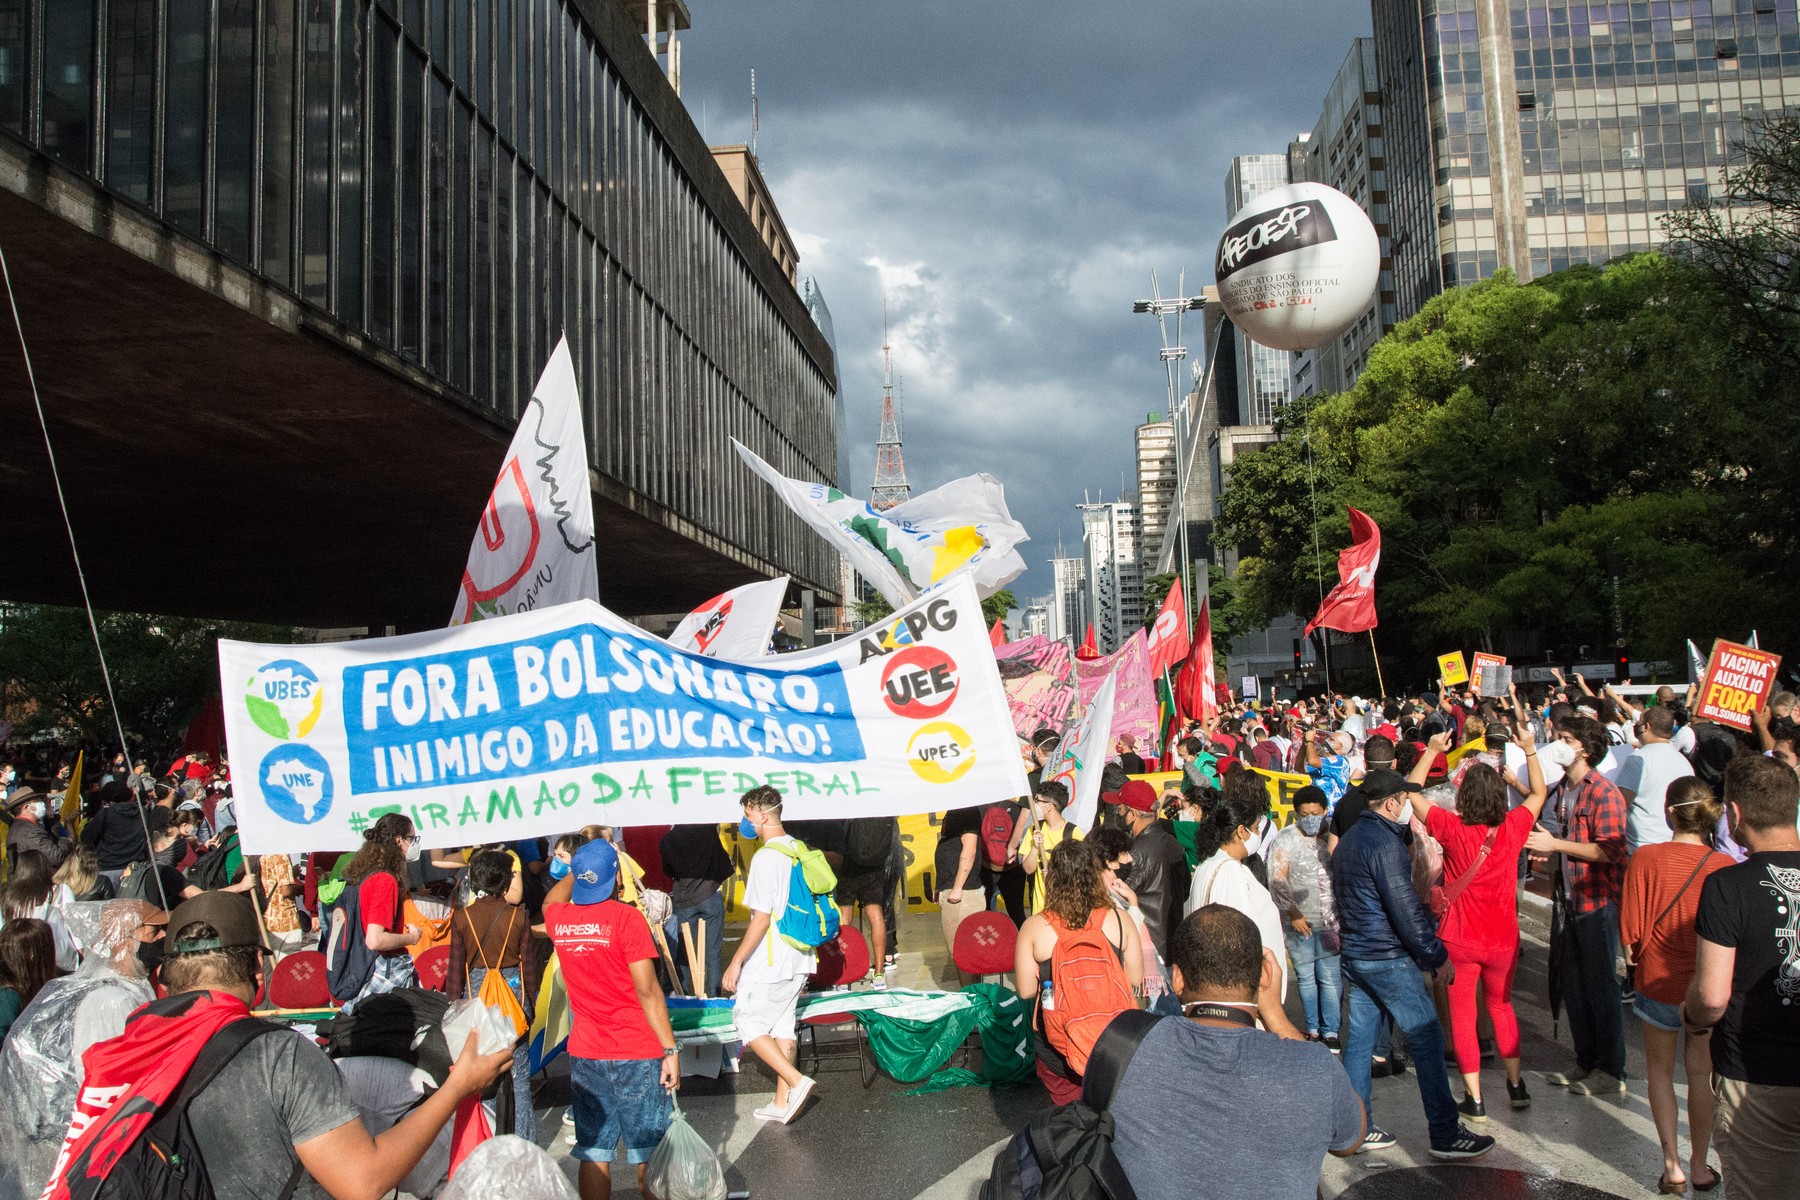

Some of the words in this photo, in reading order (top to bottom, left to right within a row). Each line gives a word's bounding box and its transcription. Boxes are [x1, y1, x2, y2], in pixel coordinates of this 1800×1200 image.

[1217, 205, 1311, 272] APEOESP
[1230, 275, 1273, 289] SINDICATO
[1276, 272, 1296, 281] DOS
[1250, 285, 1262, 294] DO
[1264, 280, 1299, 292] ENSINO
[1302, 278, 1341, 287] OFICIAL
[1257, 292, 1269, 301] DE
[1292, 287, 1322, 296] PAULO
[1719, 652, 1768, 678] VACINA
[264, 679, 313, 700] UBES
[361, 656, 502, 732] FORA
[512, 633, 836, 716] BOLSONARO,
[885, 663, 956, 706] UEE
[1713, 669, 1764, 694] AUXÍLIO
[1706, 683, 1758, 714] FORA
[373, 726, 534, 788] INIMIGO
[544, 713, 600, 763] DA
[609, 708, 834, 758] EDUCAÇÃO!
[918, 742, 962, 762] UPES
[282, 773, 315, 789] UNE
[665, 766, 882, 805] FEDERAL
[1197, 1006, 1228, 1018] Canon
